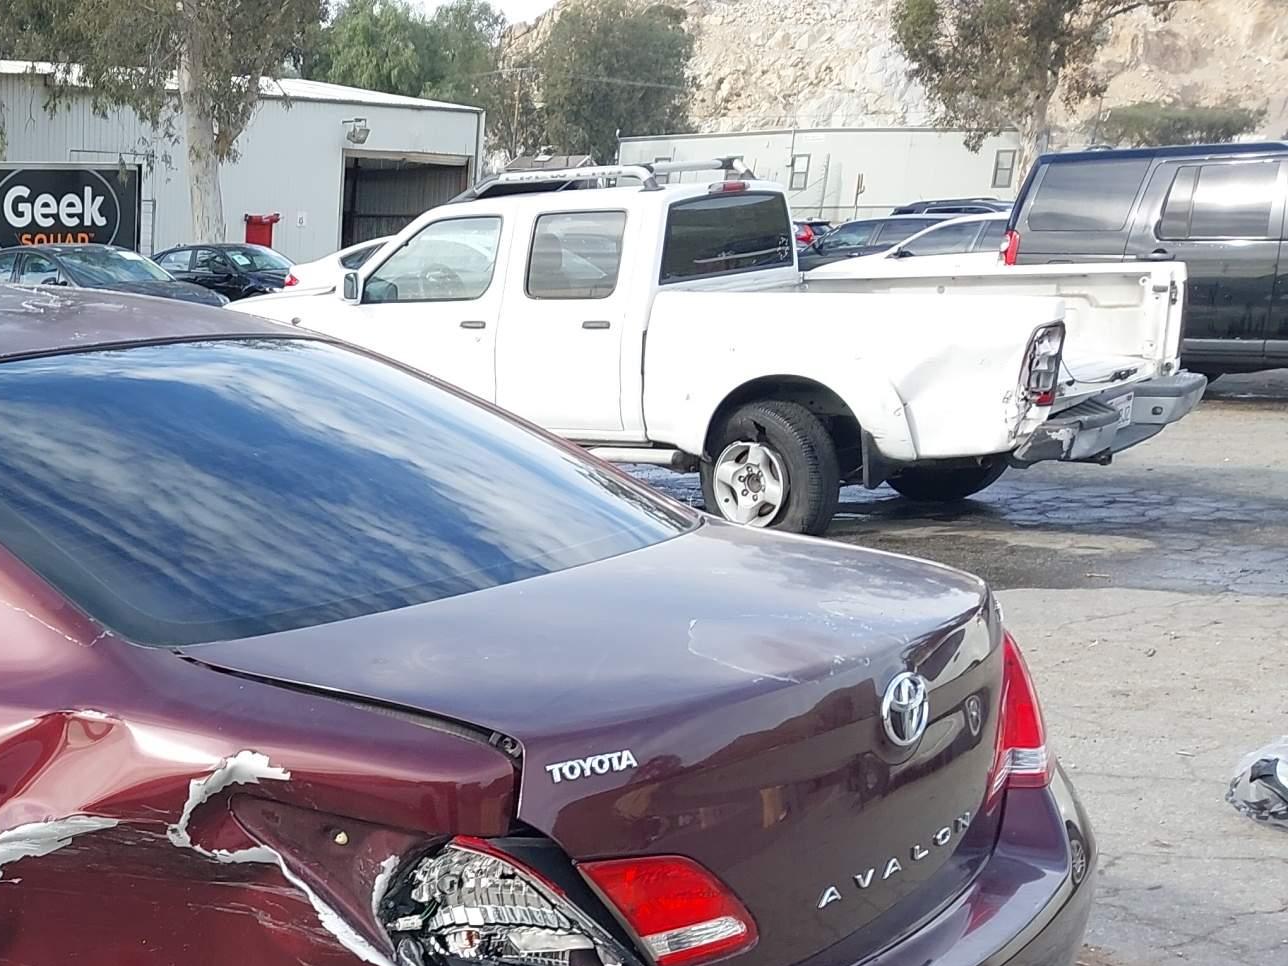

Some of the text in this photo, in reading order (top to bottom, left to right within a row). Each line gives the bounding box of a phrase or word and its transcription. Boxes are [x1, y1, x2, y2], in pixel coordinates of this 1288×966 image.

[3, 185, 108, 228] Geek
[545, 749, 638, 783] TOYOTA
[816, 811, 971, 909] AVALON
